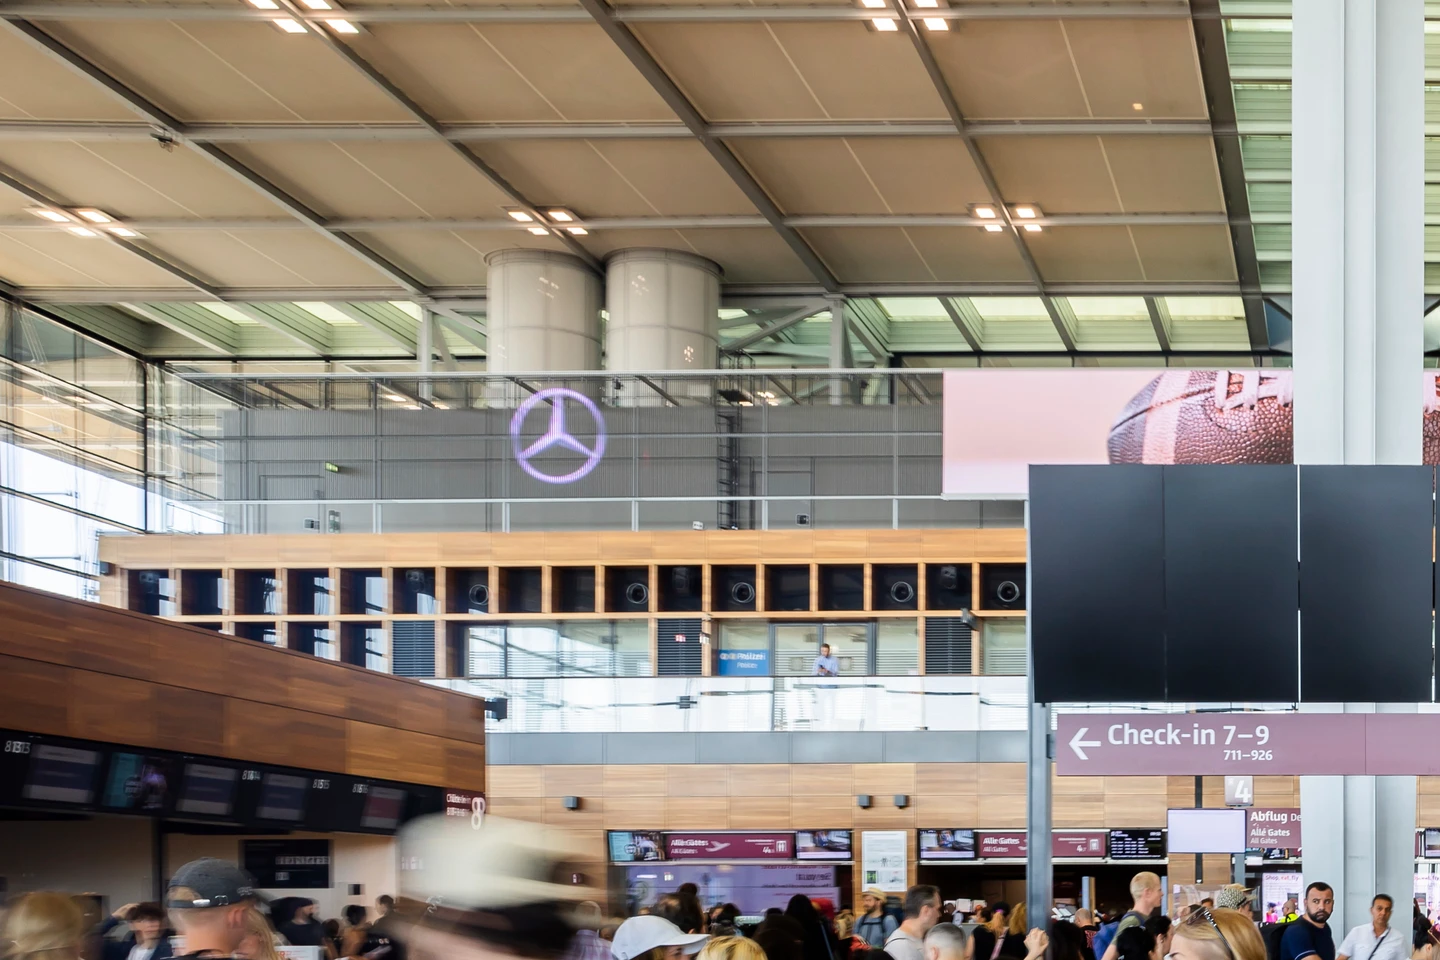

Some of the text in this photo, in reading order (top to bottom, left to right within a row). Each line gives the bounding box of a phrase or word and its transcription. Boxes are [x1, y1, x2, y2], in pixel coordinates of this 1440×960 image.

[1107, 723, 1216, 745] Check-in
[1234, 780, 1251, 803] 4
[1250, 811, 1288, 824] Abflug
[1250, 828, 1291, 837] Alle Gates
